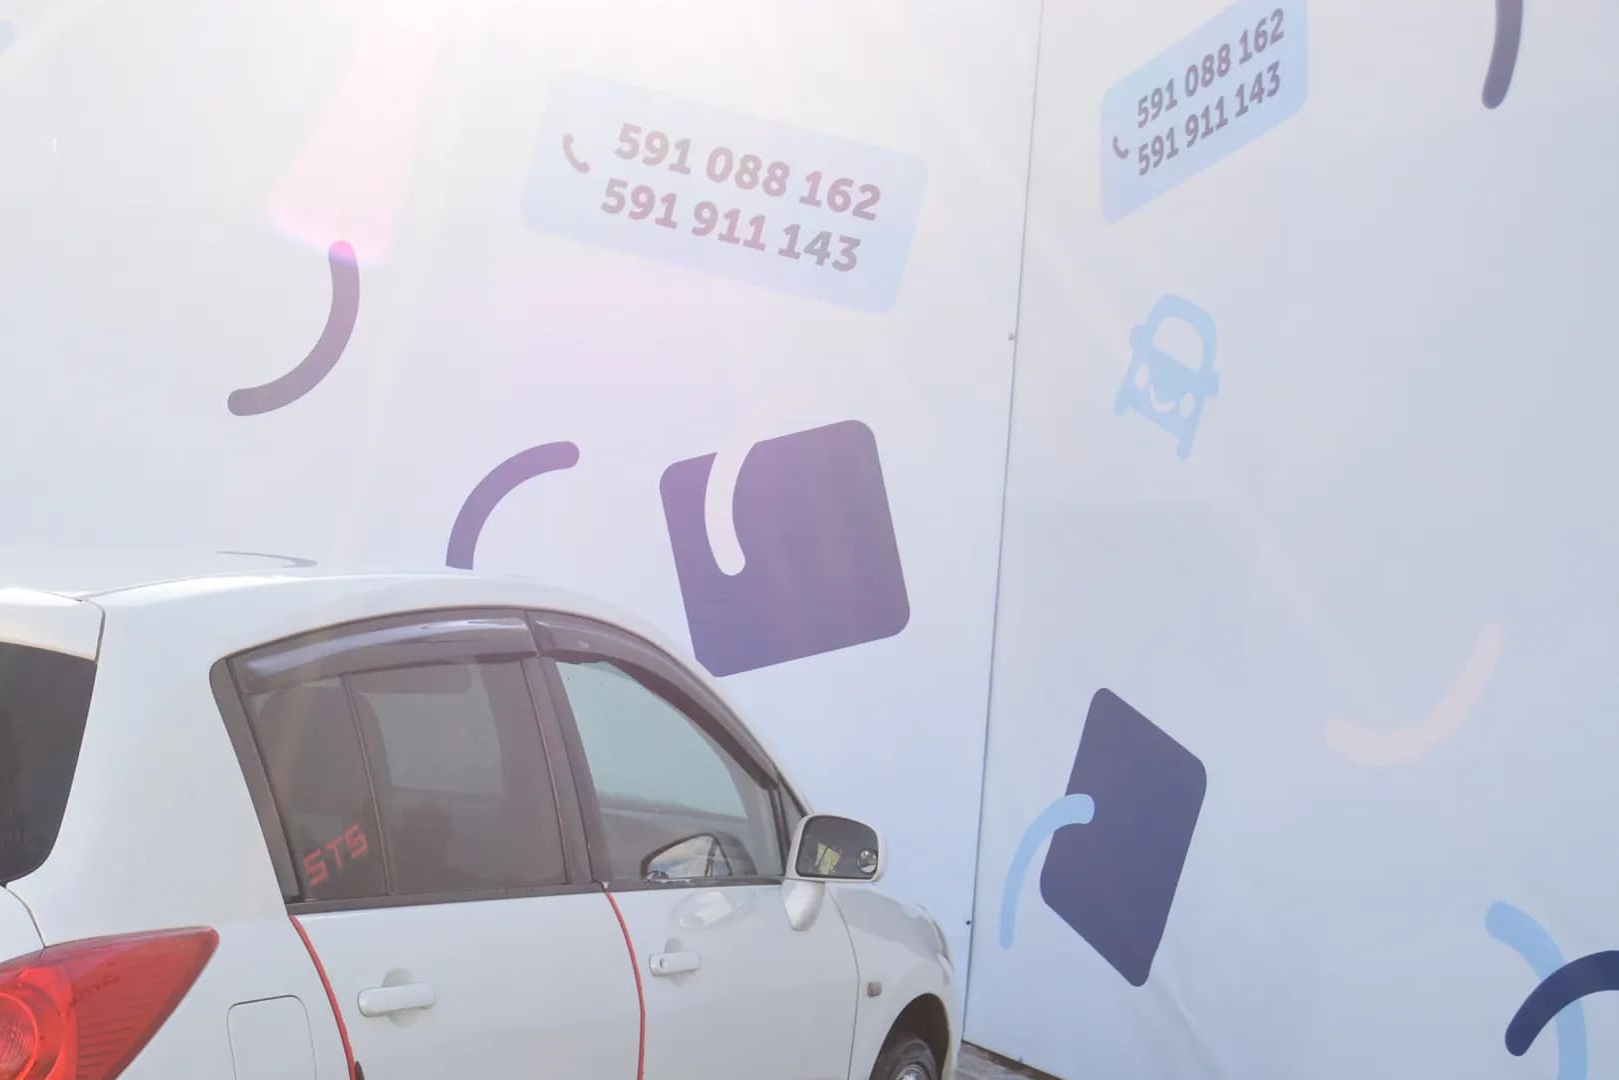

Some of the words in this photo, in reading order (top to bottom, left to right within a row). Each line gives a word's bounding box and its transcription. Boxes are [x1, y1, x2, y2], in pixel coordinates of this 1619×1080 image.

[1137, 78, 1178, 128] 591
[1184, 43, 1231, 97] 088
[1238, 8, 1284, 64] 162
[1138, 126, 1179, 176] 591
[1185, 96, 1228, 148] 911
[1235, 60, 1280, 118] 143
[614, 122, 692, 175] 591
[705, 146, 791, 197] 088
[798, 170, 881, 221] 162
[600, 177, 678, 229] 591
[691, 200, 767, 251] 911
[777, 223, 861, 272] 143
[303, 823, 368, 886] STS
